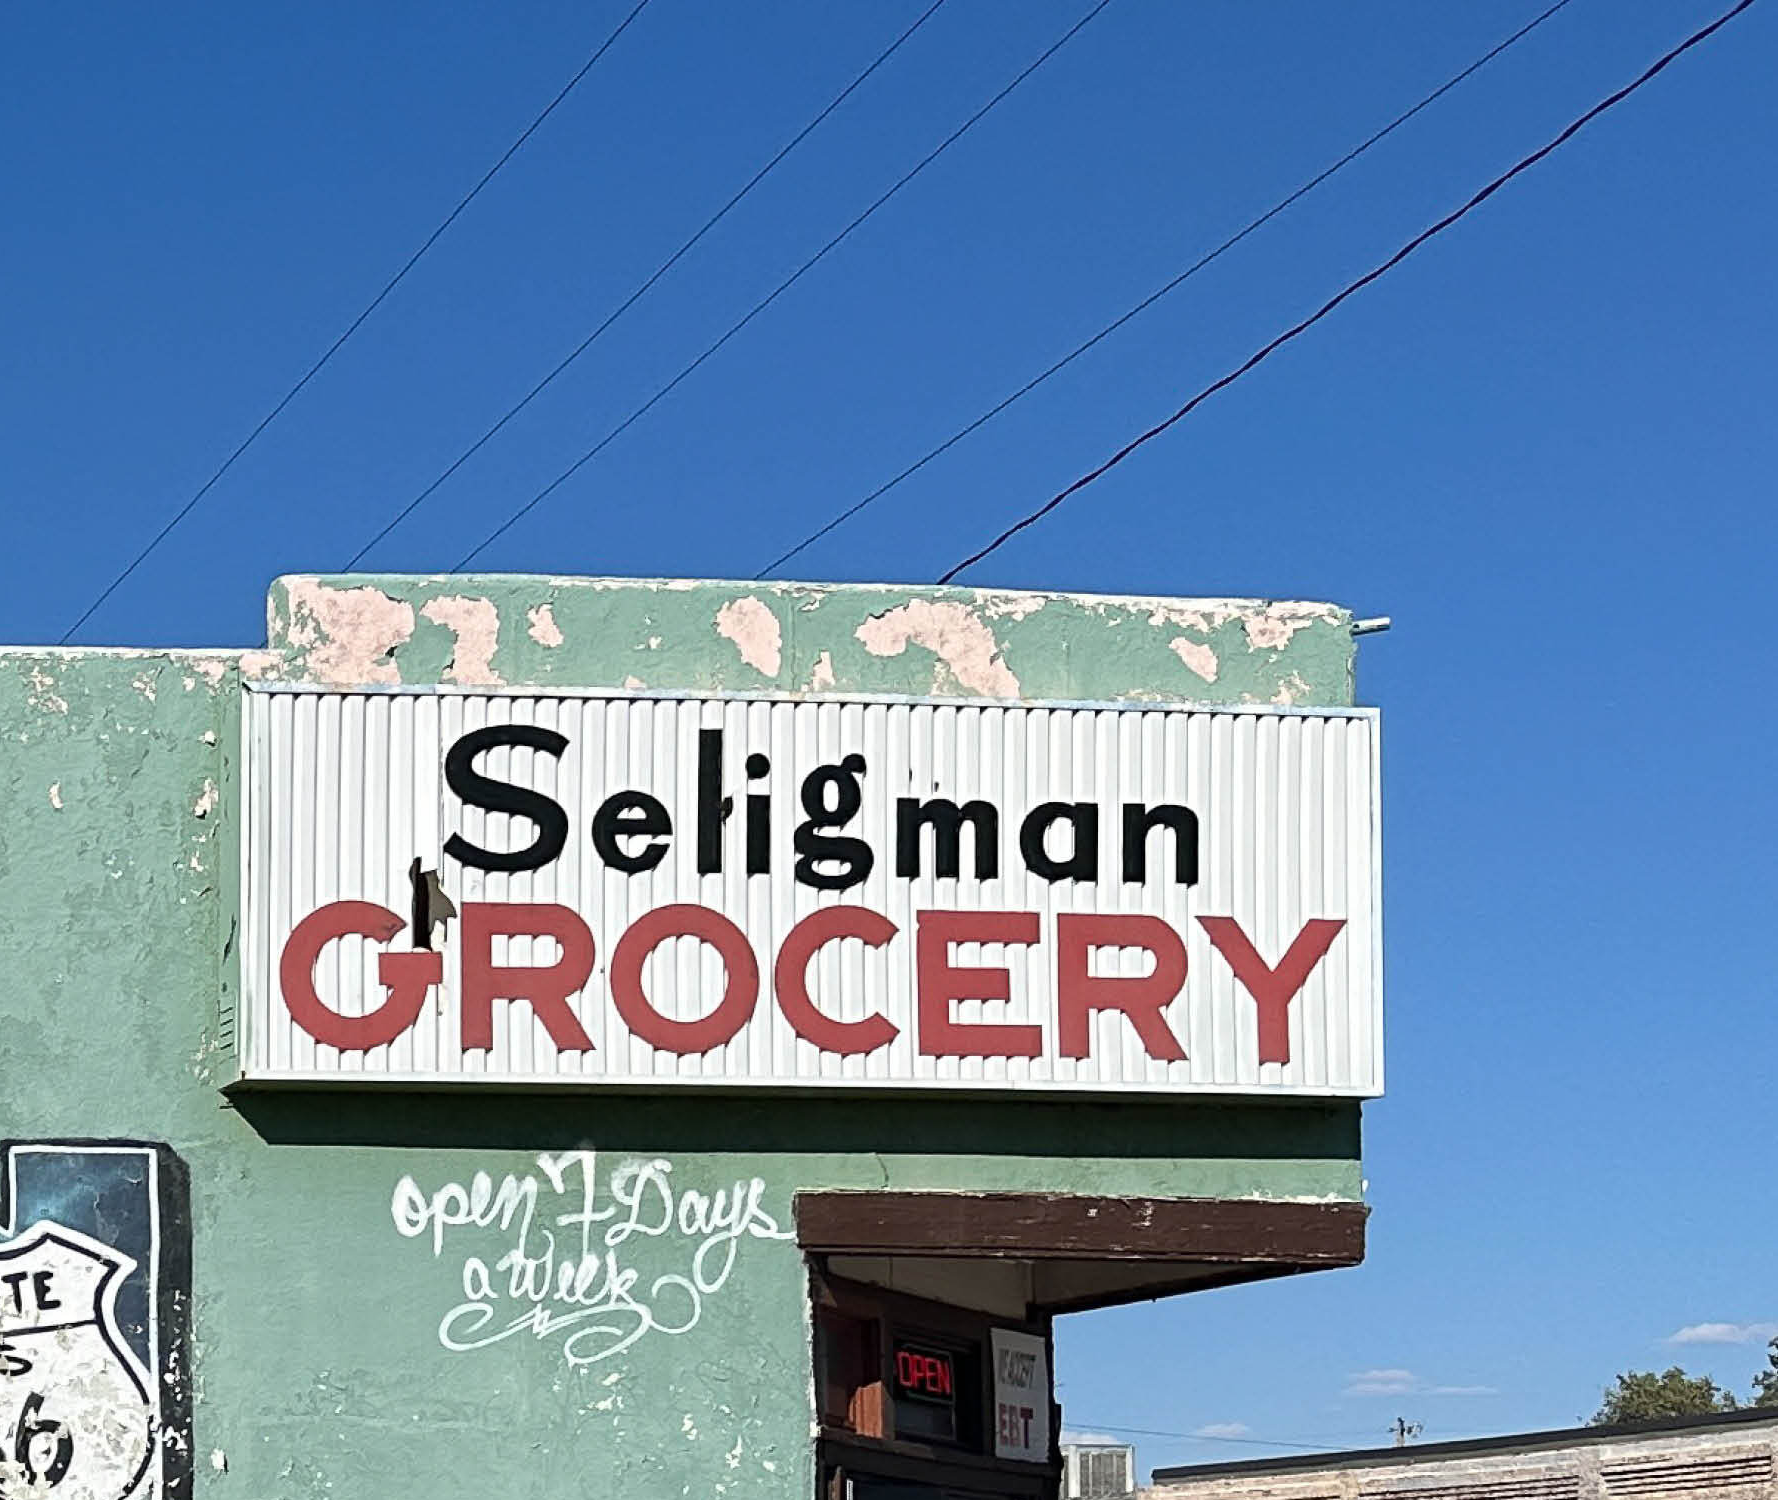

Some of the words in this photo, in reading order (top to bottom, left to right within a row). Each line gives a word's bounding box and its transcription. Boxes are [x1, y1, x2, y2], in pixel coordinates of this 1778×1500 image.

[443, 723, 1201, 890] Seligman
[278, 899, 1346, 1066] GROCERY
[537, 1146, 617, 1260] 7
[605, 1158, 795, 1294] Days
[462, 1256, 500, 1301] a
[896, 1351, 953, 1396] OPEN
[997, 1402, 1035, 1450] EBT
